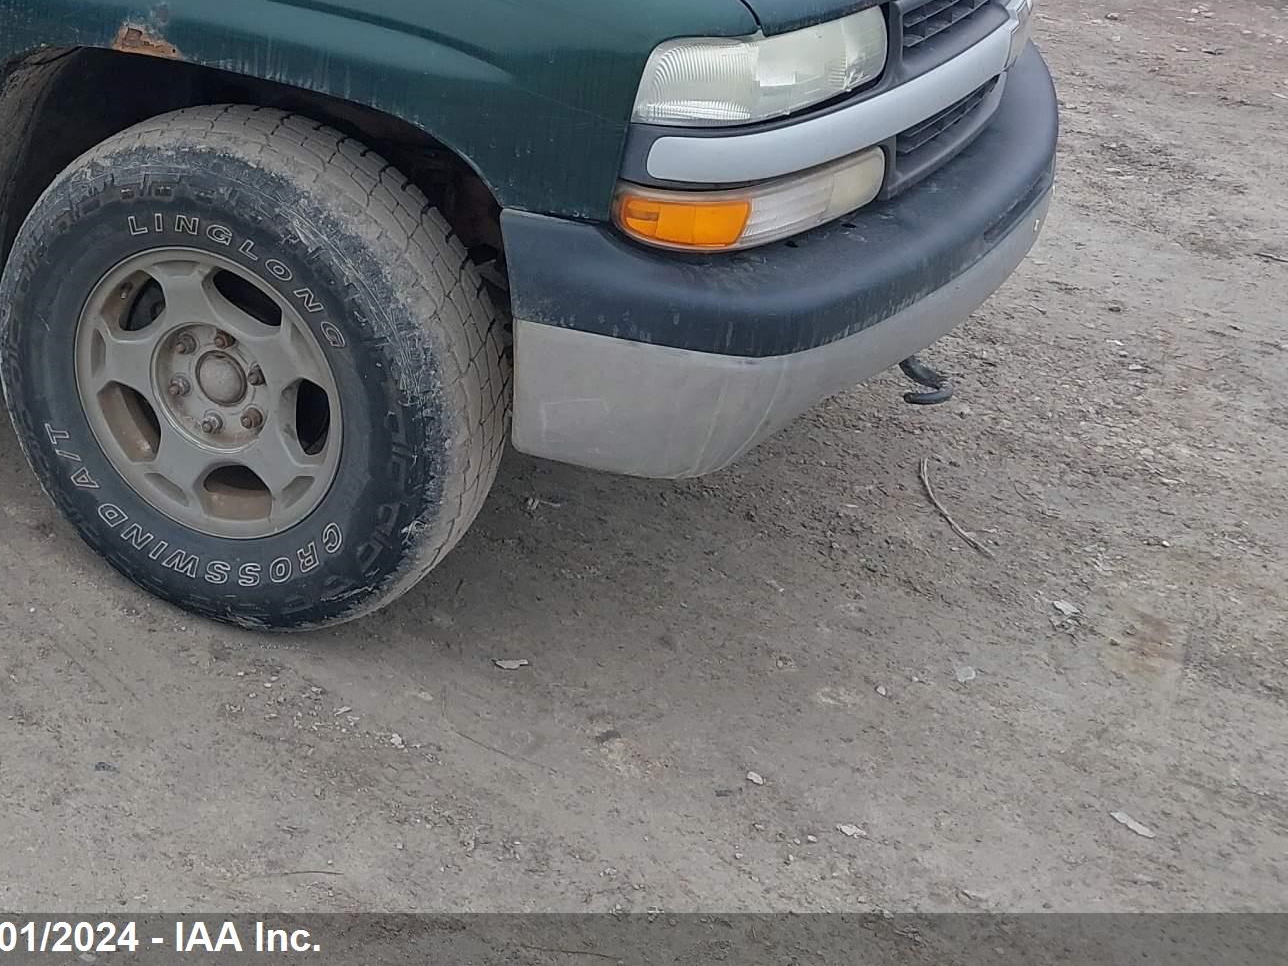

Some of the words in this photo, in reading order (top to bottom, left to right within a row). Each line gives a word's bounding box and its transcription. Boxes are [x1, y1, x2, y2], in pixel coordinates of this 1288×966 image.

[128, 213, 346, 349] LINGLONG
[44, 423, 100, 489] A/T
[98, 503, 344, 587] CROSSWIND
